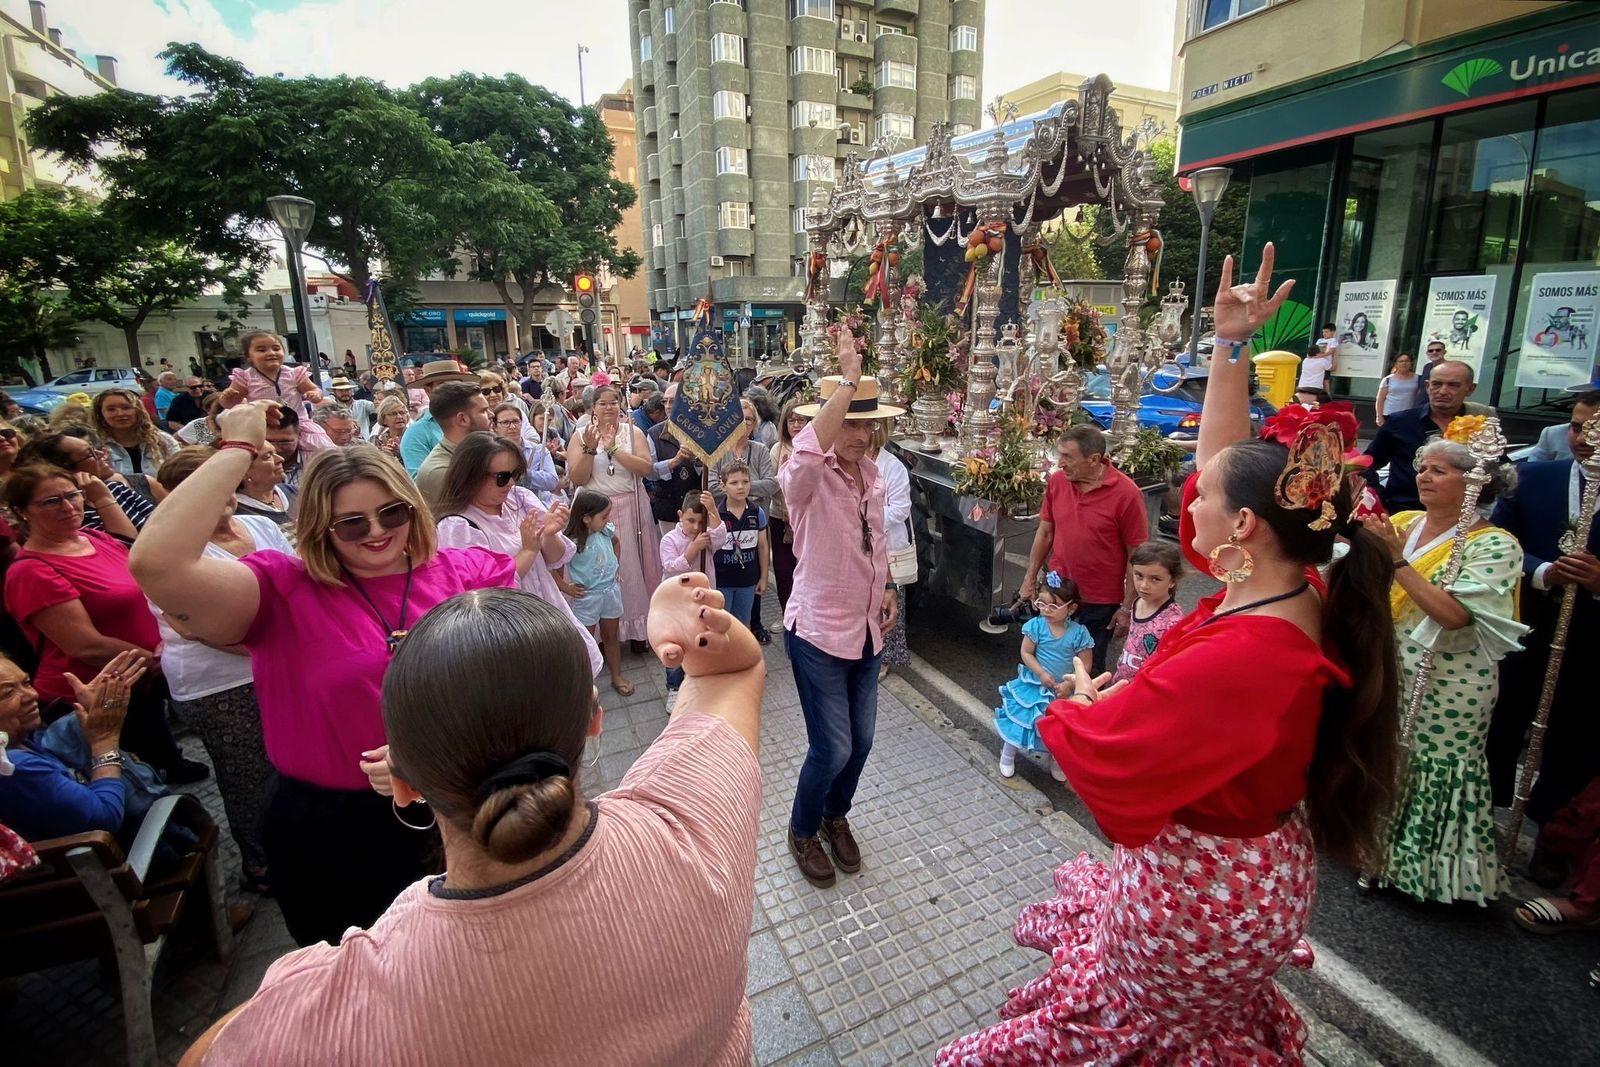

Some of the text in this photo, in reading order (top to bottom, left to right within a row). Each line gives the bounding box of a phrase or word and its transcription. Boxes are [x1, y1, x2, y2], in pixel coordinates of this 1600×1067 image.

[1510, 43, 1600, 81] Unica
[1192, 73, 1252, 100] POETA NIETO
[1344, 289, 1388, 302] SOMOS MÁS
[1436, 288, 1487, 301] SOMOS MÁS
[1538, 284, 1598, 297] SOMOS MÁS
[676, 412, 740, 439] GRUPO JOVEN
